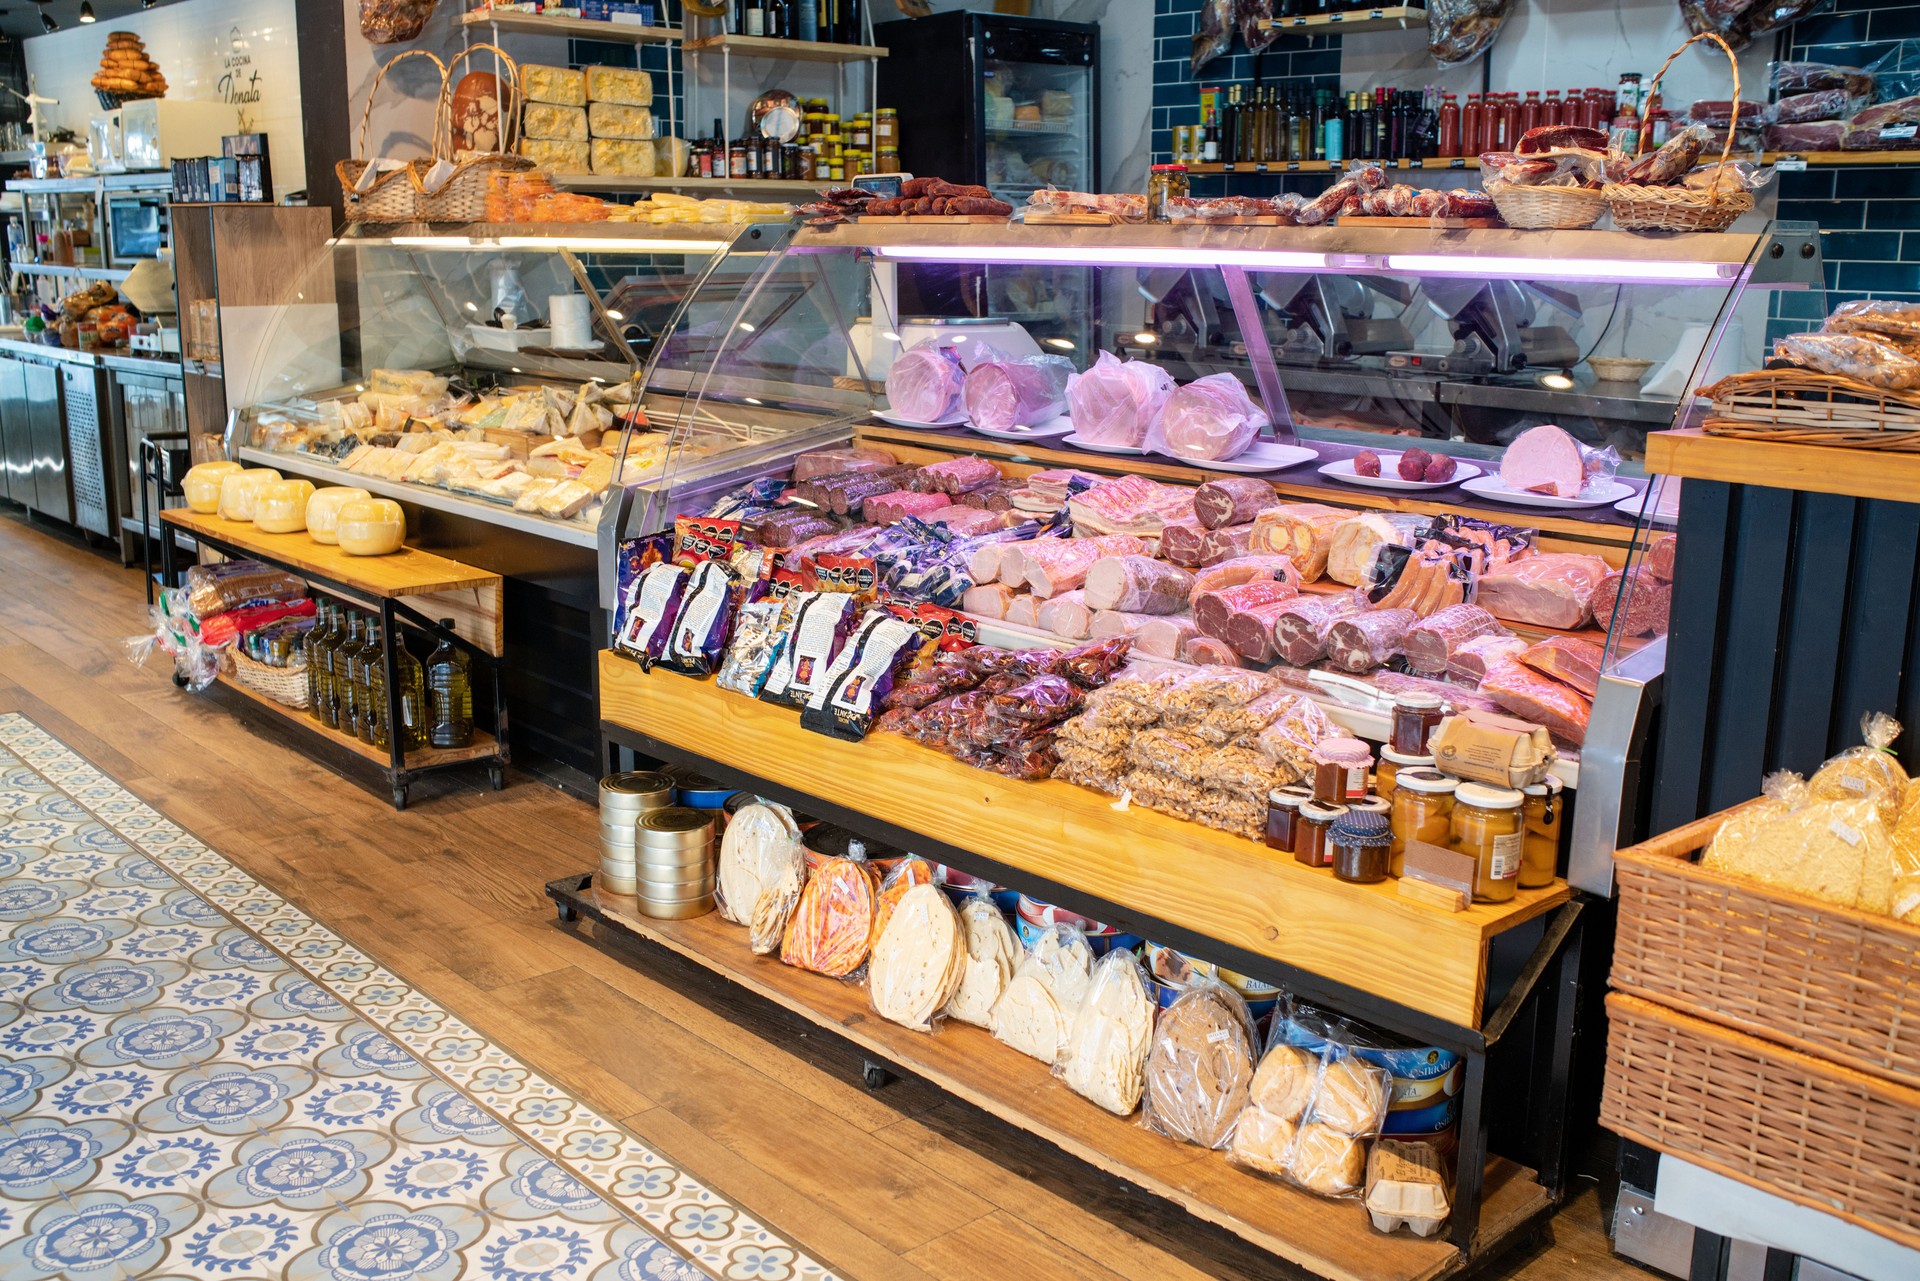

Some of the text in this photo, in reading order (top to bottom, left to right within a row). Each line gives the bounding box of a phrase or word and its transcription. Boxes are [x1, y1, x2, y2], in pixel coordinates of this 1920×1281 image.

[224, 55, 250, 68] LA COCINA
[235, 68, 242, 78] DE
[218, 69, 262, 104] Donata
[834, 708, 856, 720] PICANTE
